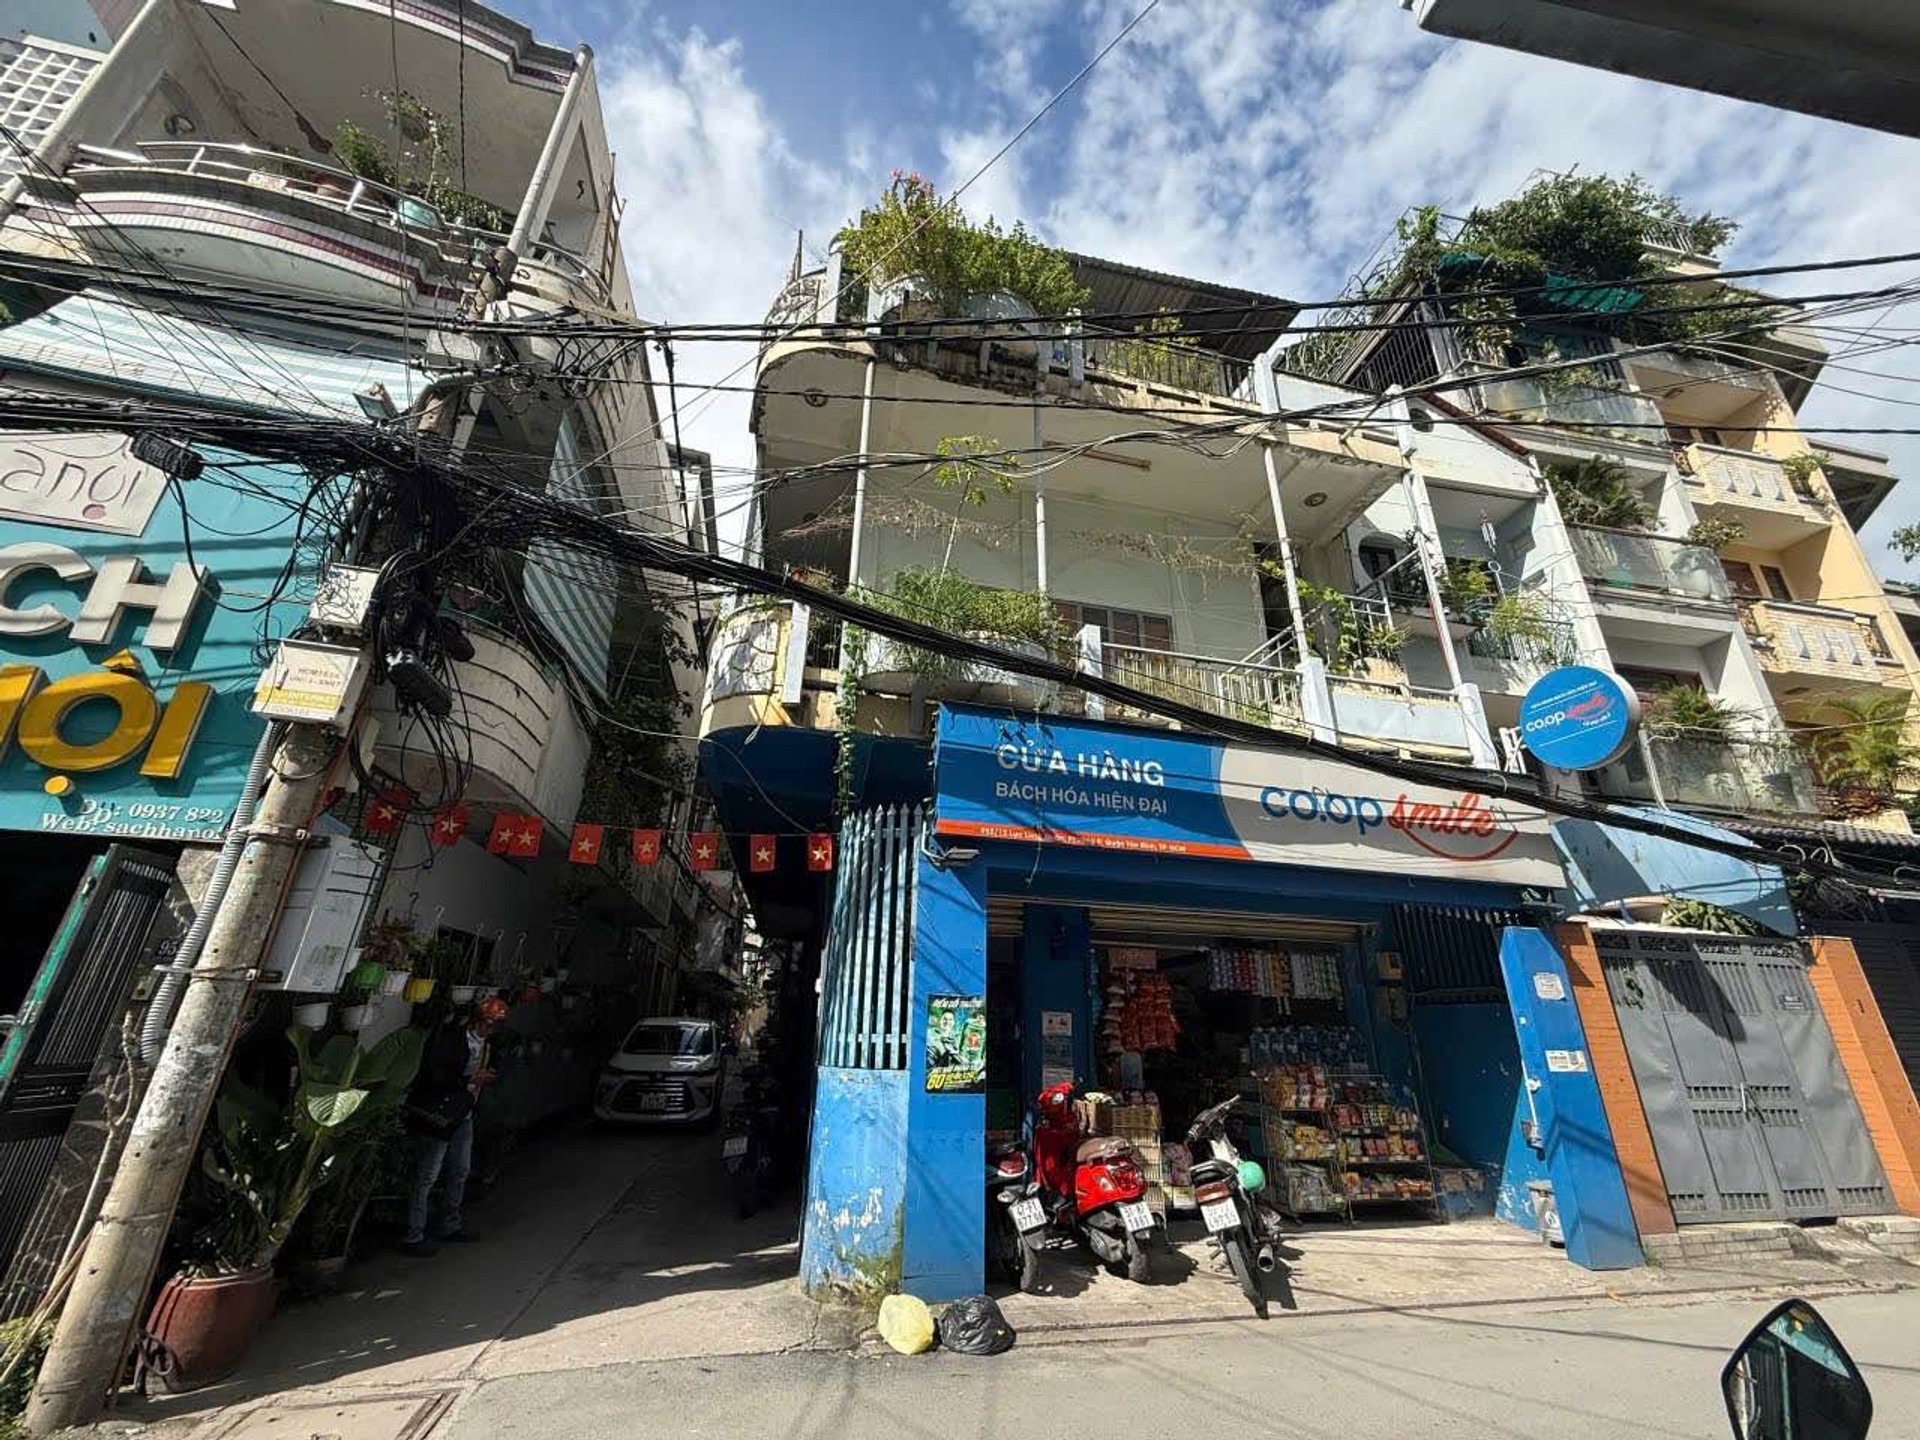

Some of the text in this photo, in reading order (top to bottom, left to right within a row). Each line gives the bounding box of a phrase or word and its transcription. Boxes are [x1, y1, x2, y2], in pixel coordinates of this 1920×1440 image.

[997, 740, 1165, 786] CỬA HÀNG
[127, 802, 182, 820] 0937
[184, 806, 225, 824] 822
[996, 779, 1167, 817] BÁCH HÓA HIỆN ĐẠI
[1387, 792, 1497, 838] smile
[41, 812, 98, 833] Web:
